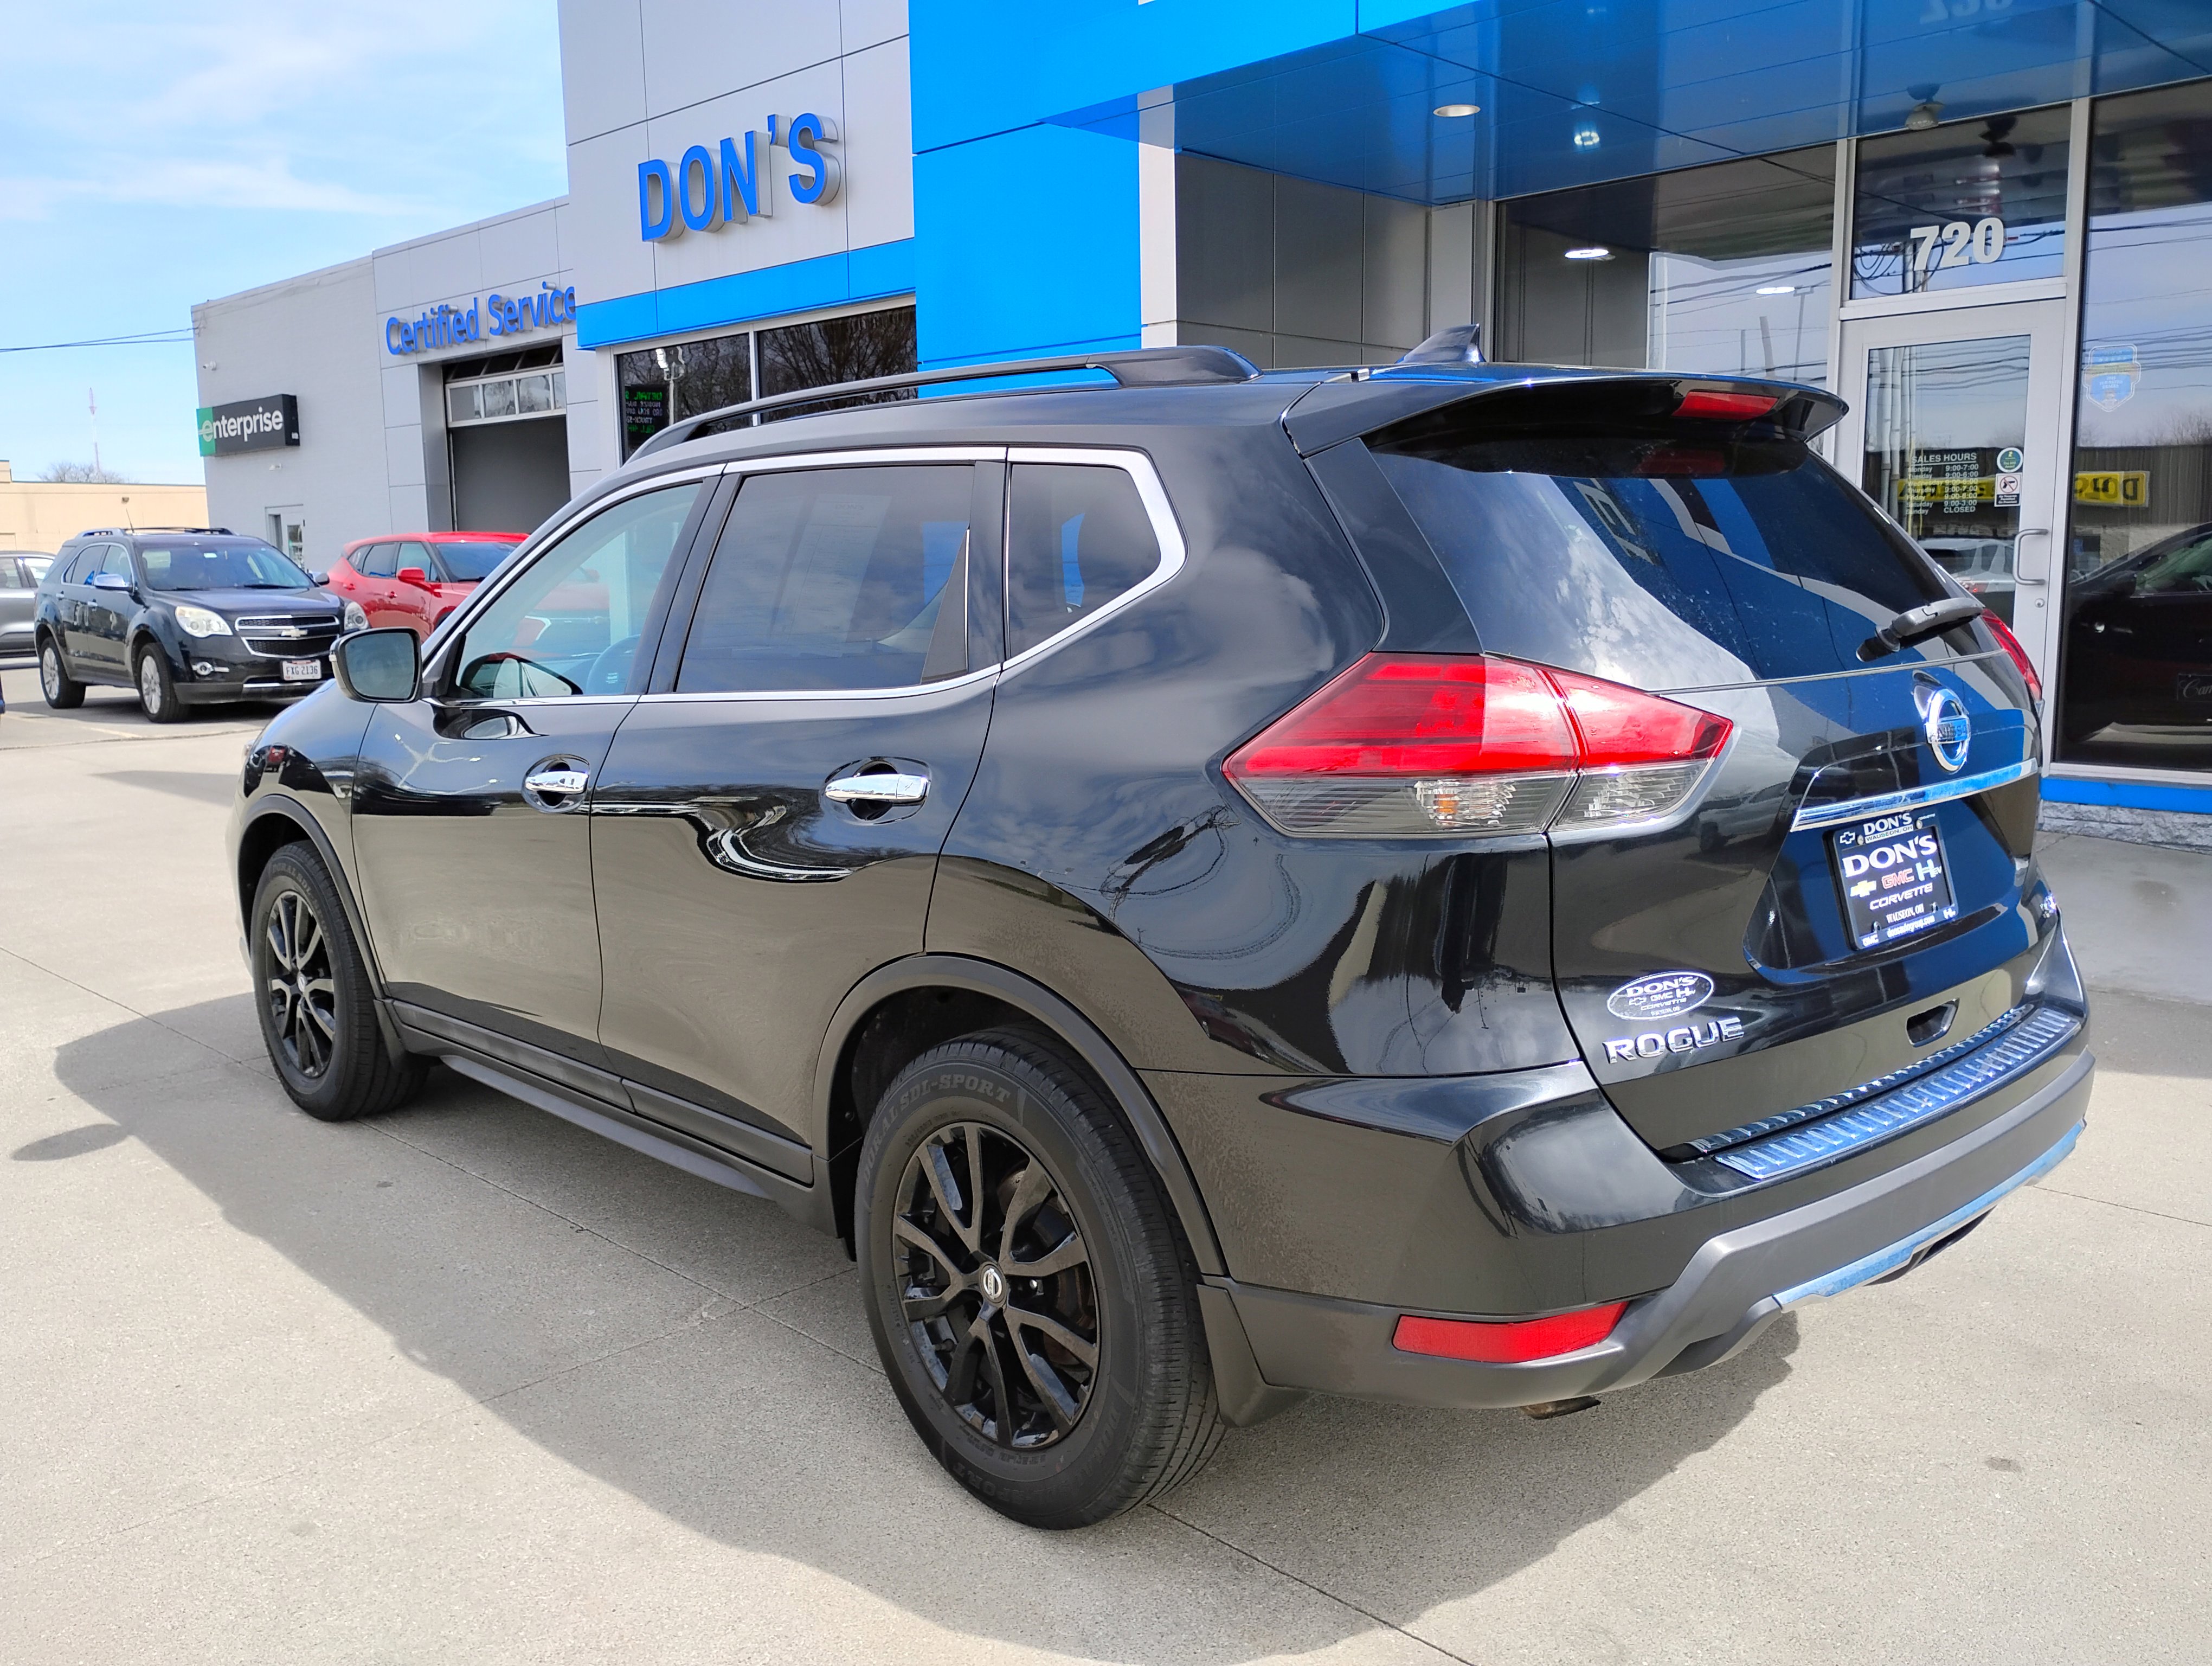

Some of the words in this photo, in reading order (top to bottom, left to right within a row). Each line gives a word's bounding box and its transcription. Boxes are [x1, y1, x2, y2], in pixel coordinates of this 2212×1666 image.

[638, 112, 835, 242] DON'S
[1910, 217, 2004, 271] 720
[386, 297, 480, 355] Certified
[488, 281, 577, 336] Service
[198, 406, 284, 442] enterprise
[1911, 454, 1941, 464] SALES
[1944, 453, 1977, 462] HOURS
[286, 667, 299, 675] FXG
[301, 665, 318, 675] 2136
[1863, 812, 1913, 836] DON'S
[1866, 828, 1901, 842] WAUSEON,
[1842, 835, 1938, 878] DON'S
[1881, 868, 1915, 889] GMC
[1869, 882, 1933, 911] CORVETTE
[1626, 976, 1698, 997] DON'S
[1650, 991, 1674, 1002] GMC
[1640, 997, 1687, 1010] CORVETTE
[1602, 1016, 1745, 1064] ROGUE
[899, 1074, 1012, 1112] SDL-SPORT
